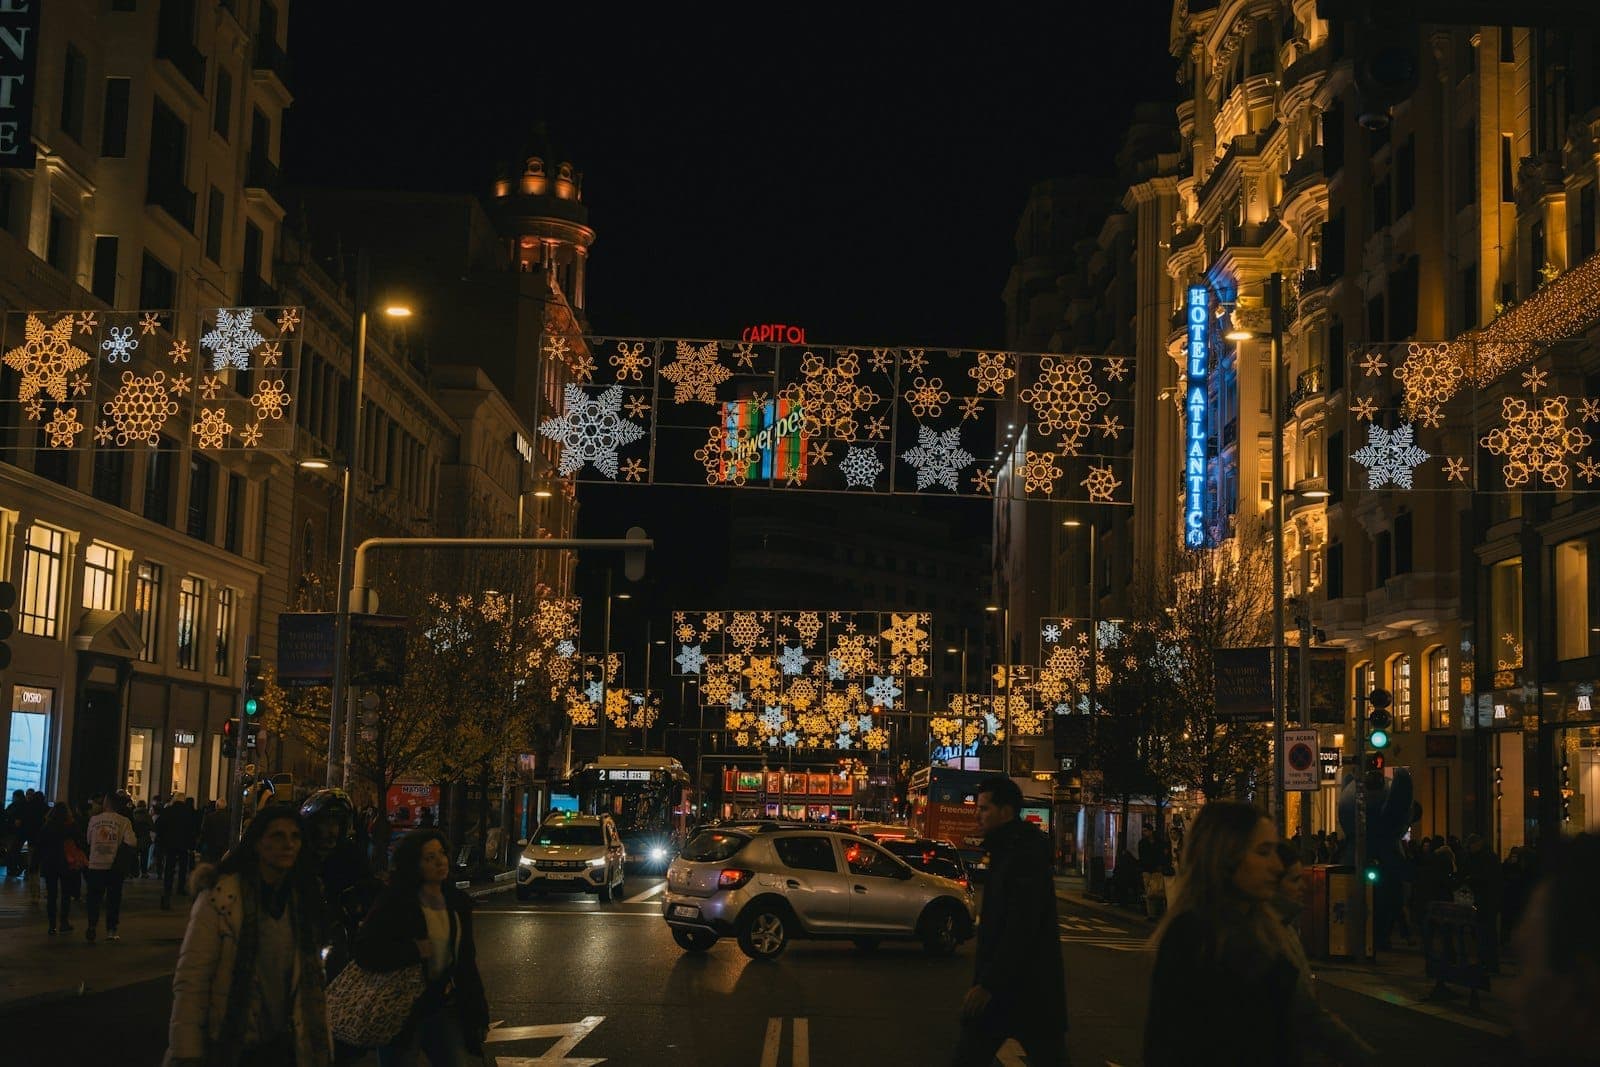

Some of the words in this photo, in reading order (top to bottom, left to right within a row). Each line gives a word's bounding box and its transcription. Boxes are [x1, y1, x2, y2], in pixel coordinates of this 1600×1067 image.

[742, 324, 808, 346] CAPITOL
[1190, 288, 1207, 377] HOTEL
[1189, 387, 1206, 546] ATLANTICO
[599, 769, 606, 781] 2
